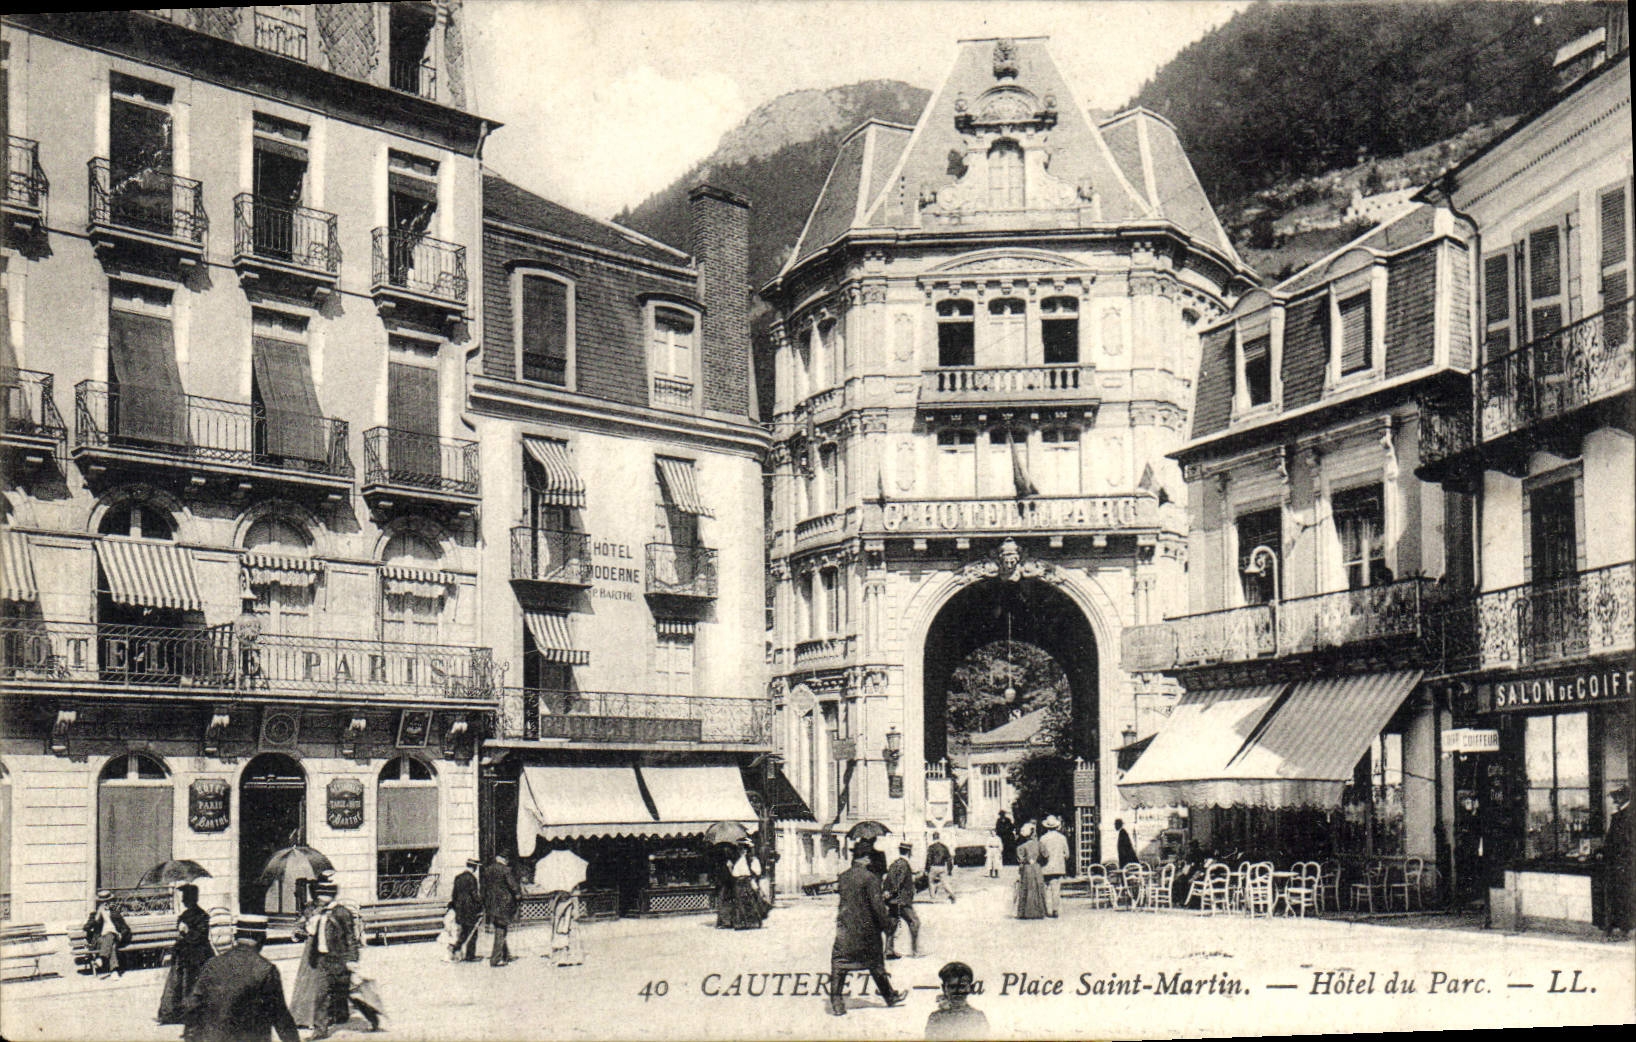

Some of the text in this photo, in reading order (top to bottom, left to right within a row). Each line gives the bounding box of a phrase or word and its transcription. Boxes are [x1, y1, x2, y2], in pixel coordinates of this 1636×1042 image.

[302, 651, 448, 686] PARIS
[1497, 679, 1555, 707] SALON
[1559, 684, 1574, 701] DE
[1462, 733, 1498, 747] COIFFEUR
